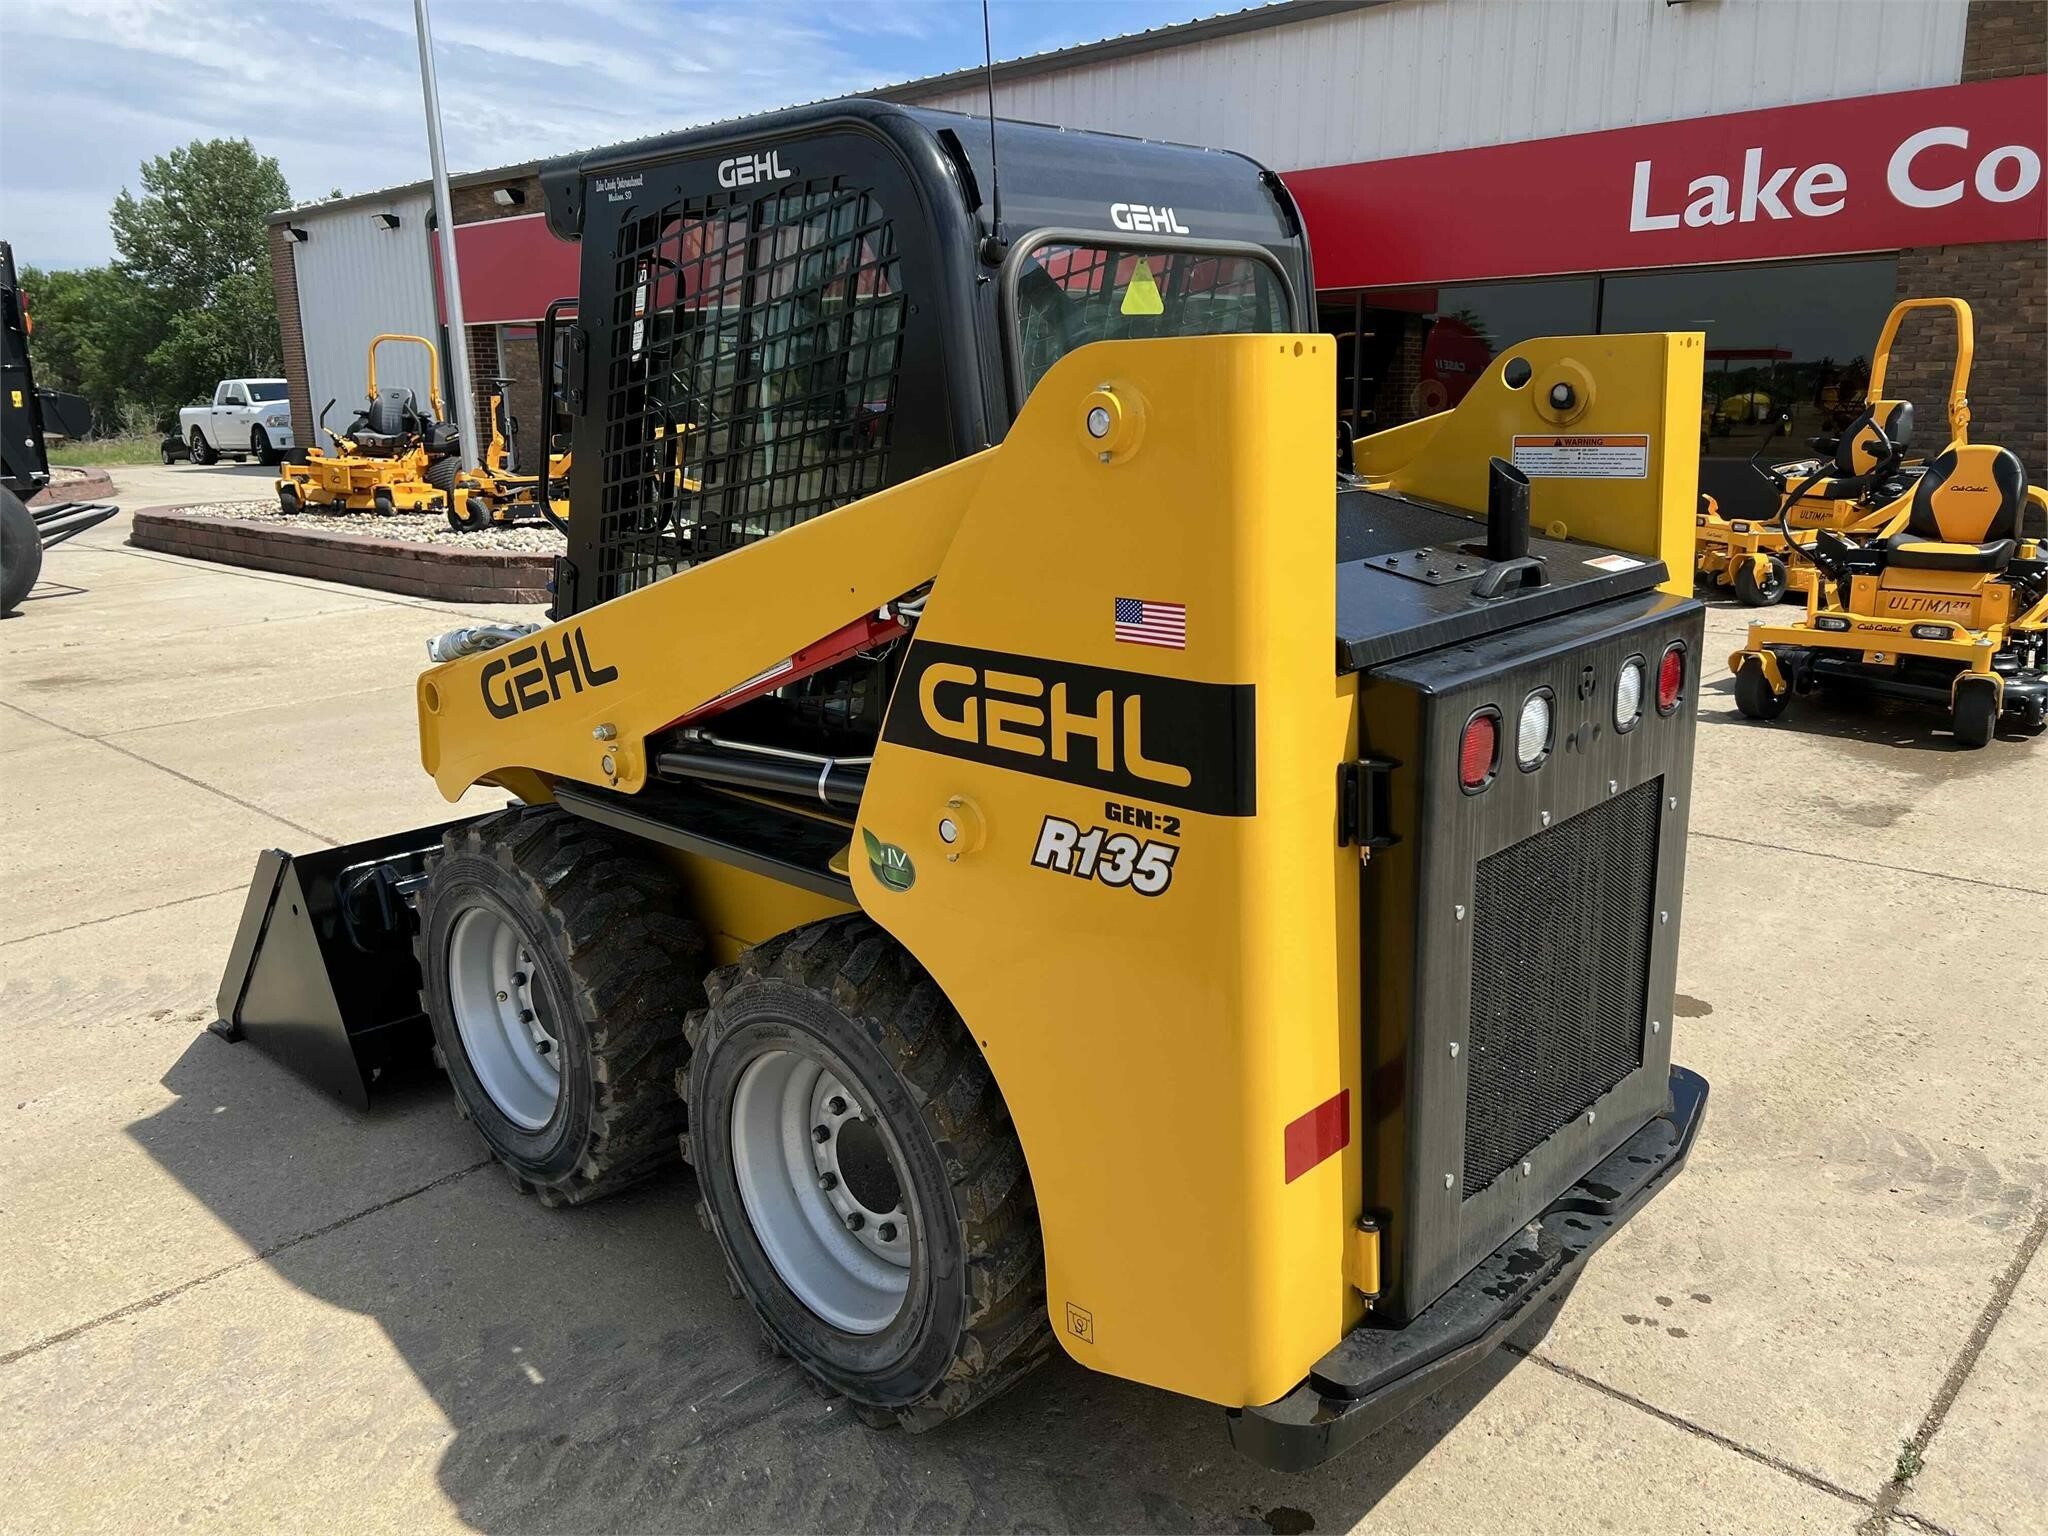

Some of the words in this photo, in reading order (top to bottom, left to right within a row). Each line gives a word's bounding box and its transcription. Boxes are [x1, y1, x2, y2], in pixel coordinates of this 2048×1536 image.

[718, 150, 791, 188] GEHL
[1629, 147, 1847, 232] Lake
[1887, 126, 2041, 208] Co
[1110, 202, 1190, 234] GEHL
[1564, 438, 1604, 447] WARNING
[1799, 510, 1825, 521] ULTIMA
[1888, 597, 1952, 614] ULTIMA
[1856, 623, 1875, 631] Cub
[1874, 624, 1903, 633] Cadet
[480, 626, 619, 720] GEHL
[918, 662, 1192, 788] GEHL
[1104, 801, 1181, 838] GEN:2
[1030, 815, 1181, 897] R135
